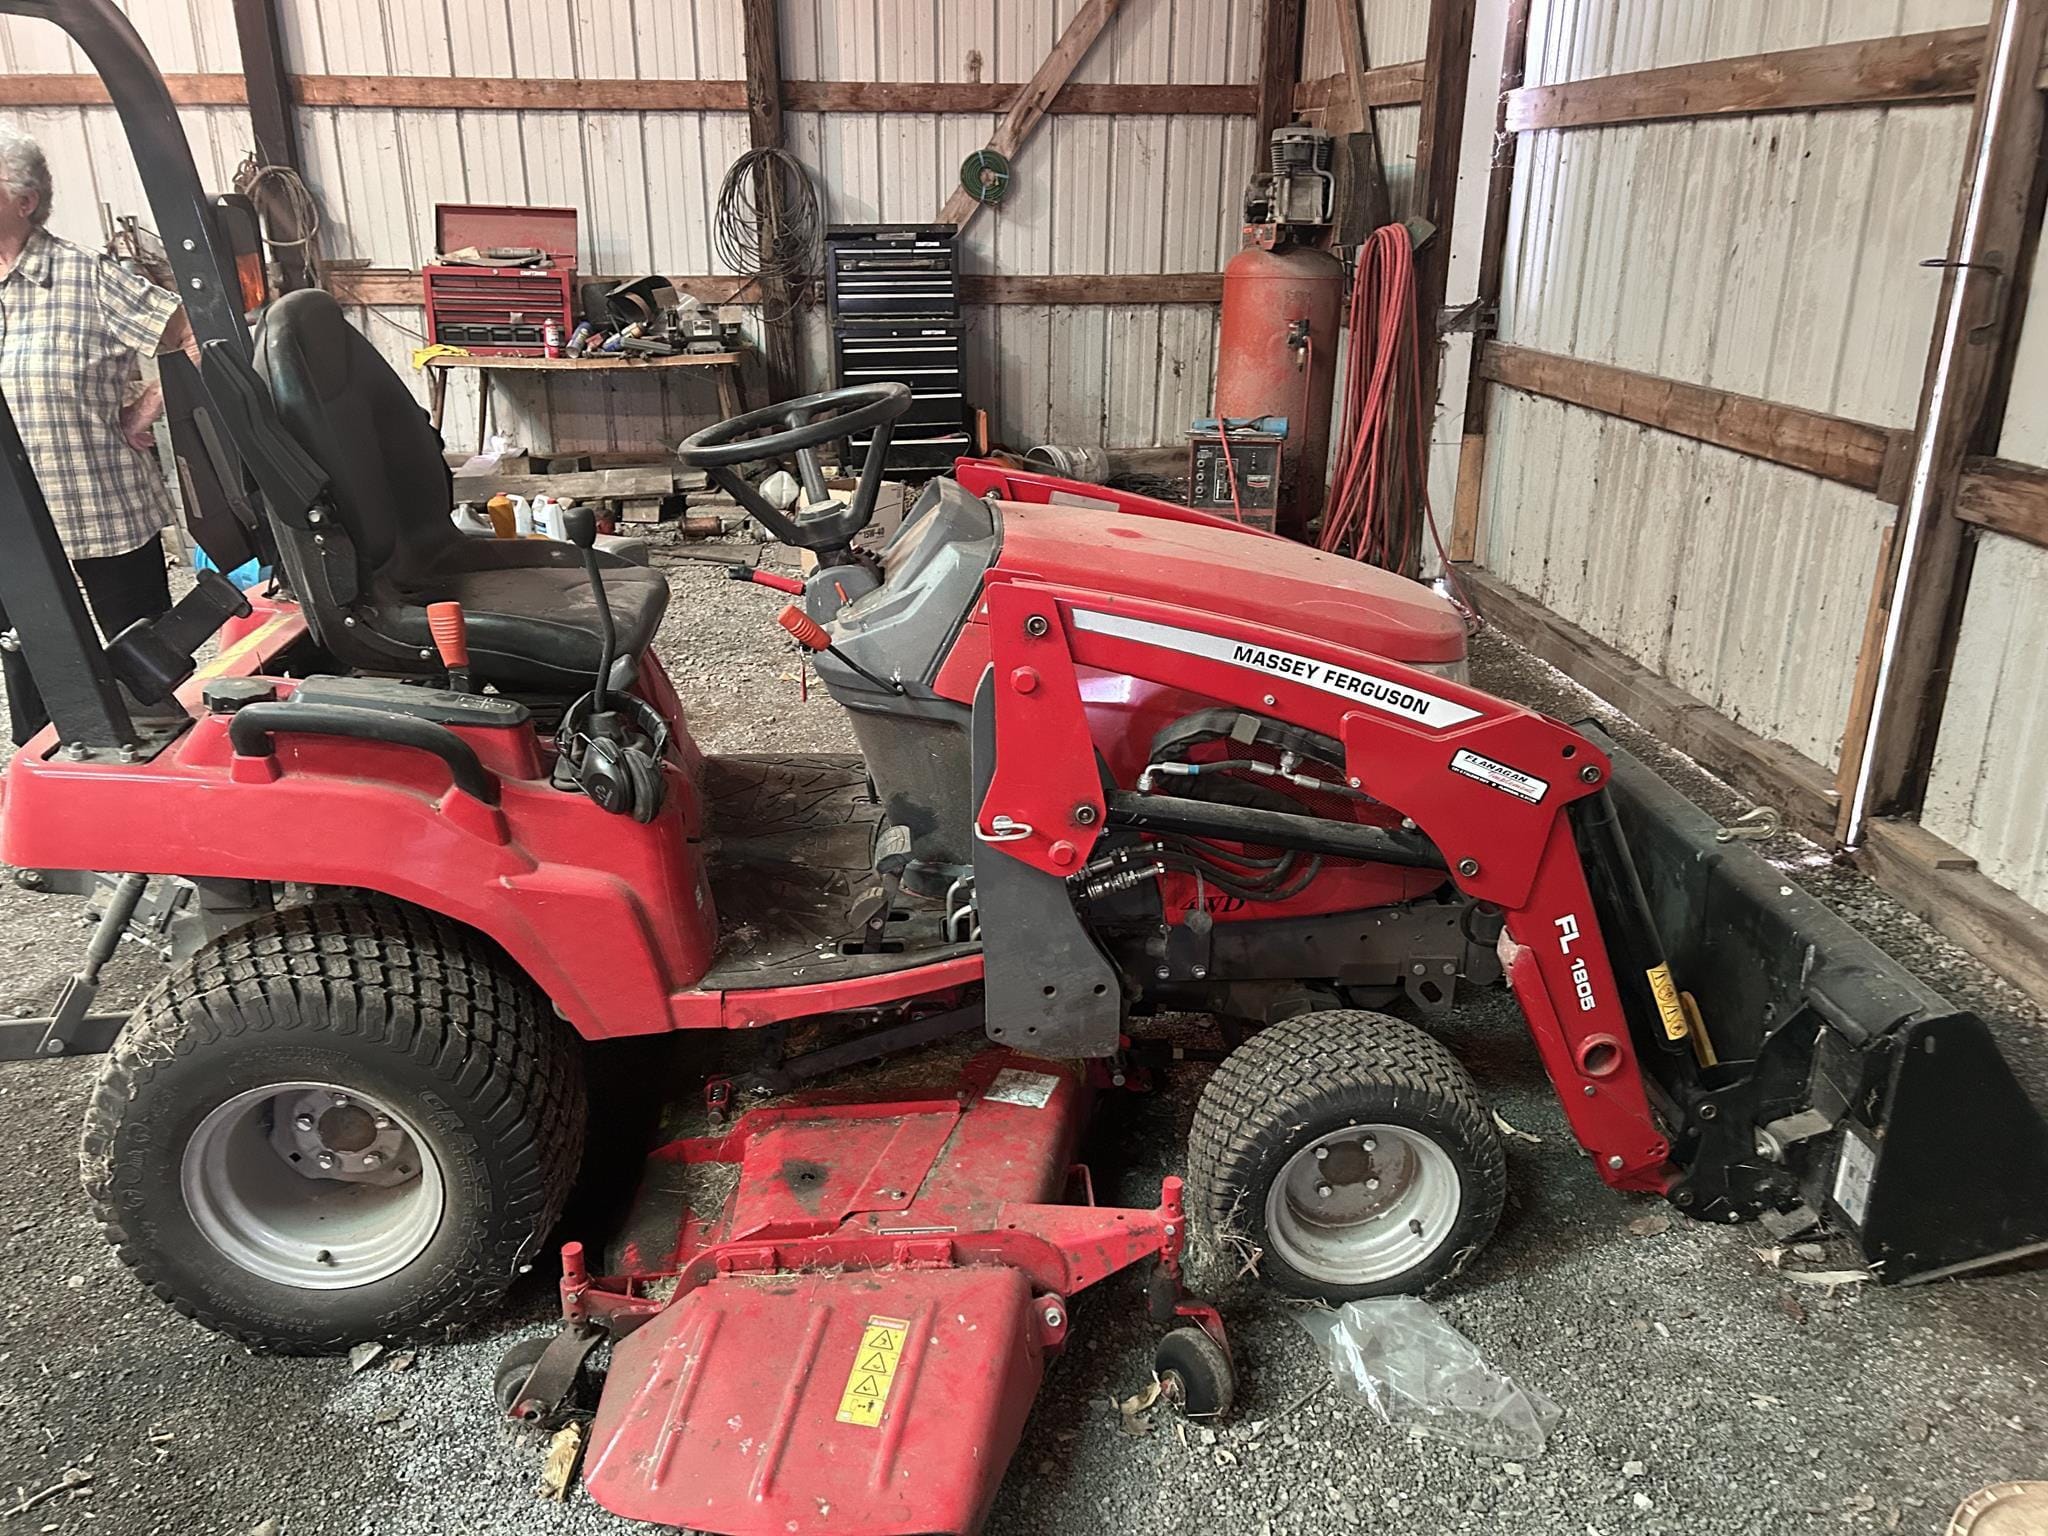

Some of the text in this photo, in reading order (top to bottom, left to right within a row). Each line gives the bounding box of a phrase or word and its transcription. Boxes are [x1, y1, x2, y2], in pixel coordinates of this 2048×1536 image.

[1232, 645, 1431, 716] MASSEY FERGUSON
[1464, 754, 1529, 783] FLANAGAN
[1554, 913, 1597, 1012] FL 1805
